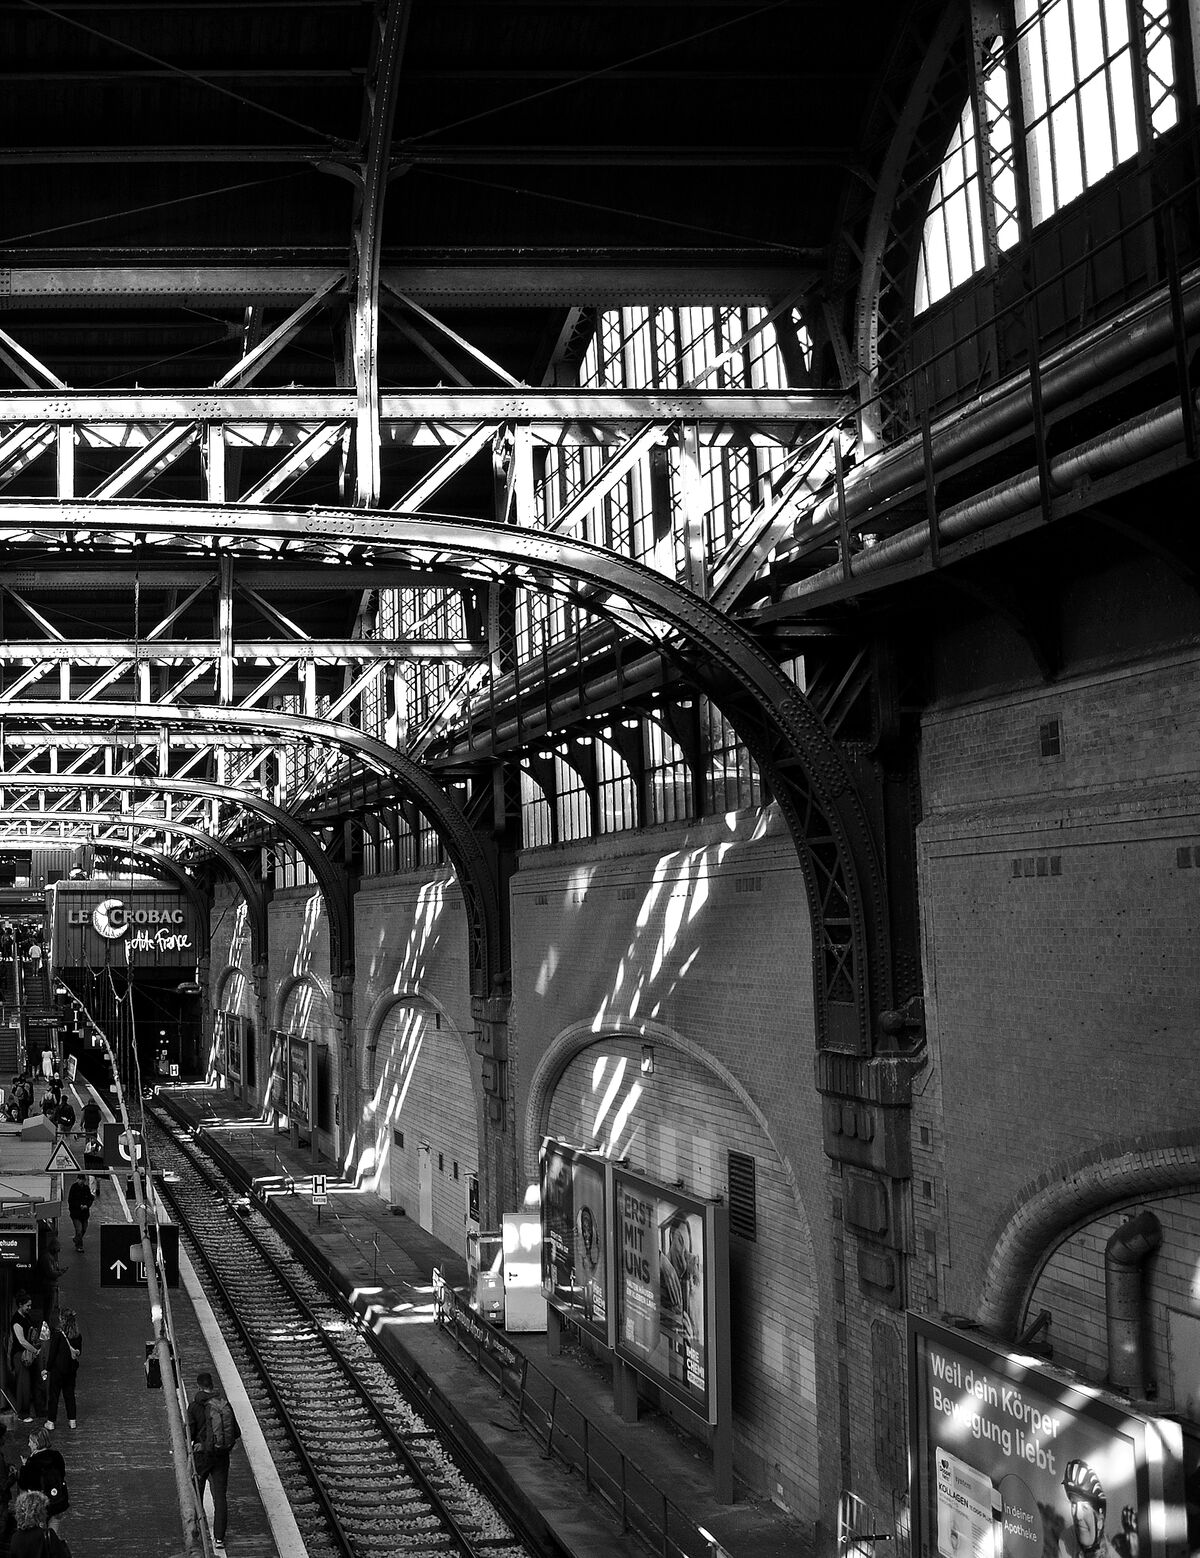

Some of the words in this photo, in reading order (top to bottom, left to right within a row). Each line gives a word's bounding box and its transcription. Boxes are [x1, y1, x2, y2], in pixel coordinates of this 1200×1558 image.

[68, 910, 90, 924] LE
[109, 909, 184, 925] CROBAG
[154, 927, 193, 953] France
[170, 1065, 179, 1075] H
[314, 1176, 325, 1194] H
[624, 1193, 654, 1229] ERST
[624, 1222, 645, 1253] MIT
[625, 1250, 650, 1285] UNS
[686, 1345, 700, 1364] IHRE
[930, 1352, 962, 1389] Weil
[964, 1369, 998, 1407] dein
[1001, 1387, 1060, 1438] Körper
[932, 1386, 1012, 1457] Bewegung
[1015, 1428, 1057, 1475] liebt
[938, 1482, 969, 1509] KOLLAGEN
[1004, 1502, 1011, 1514] In
[1011, 1505, 1034, 1524] deiner
[1004, 1519, 1037, 1542] Apotheke
